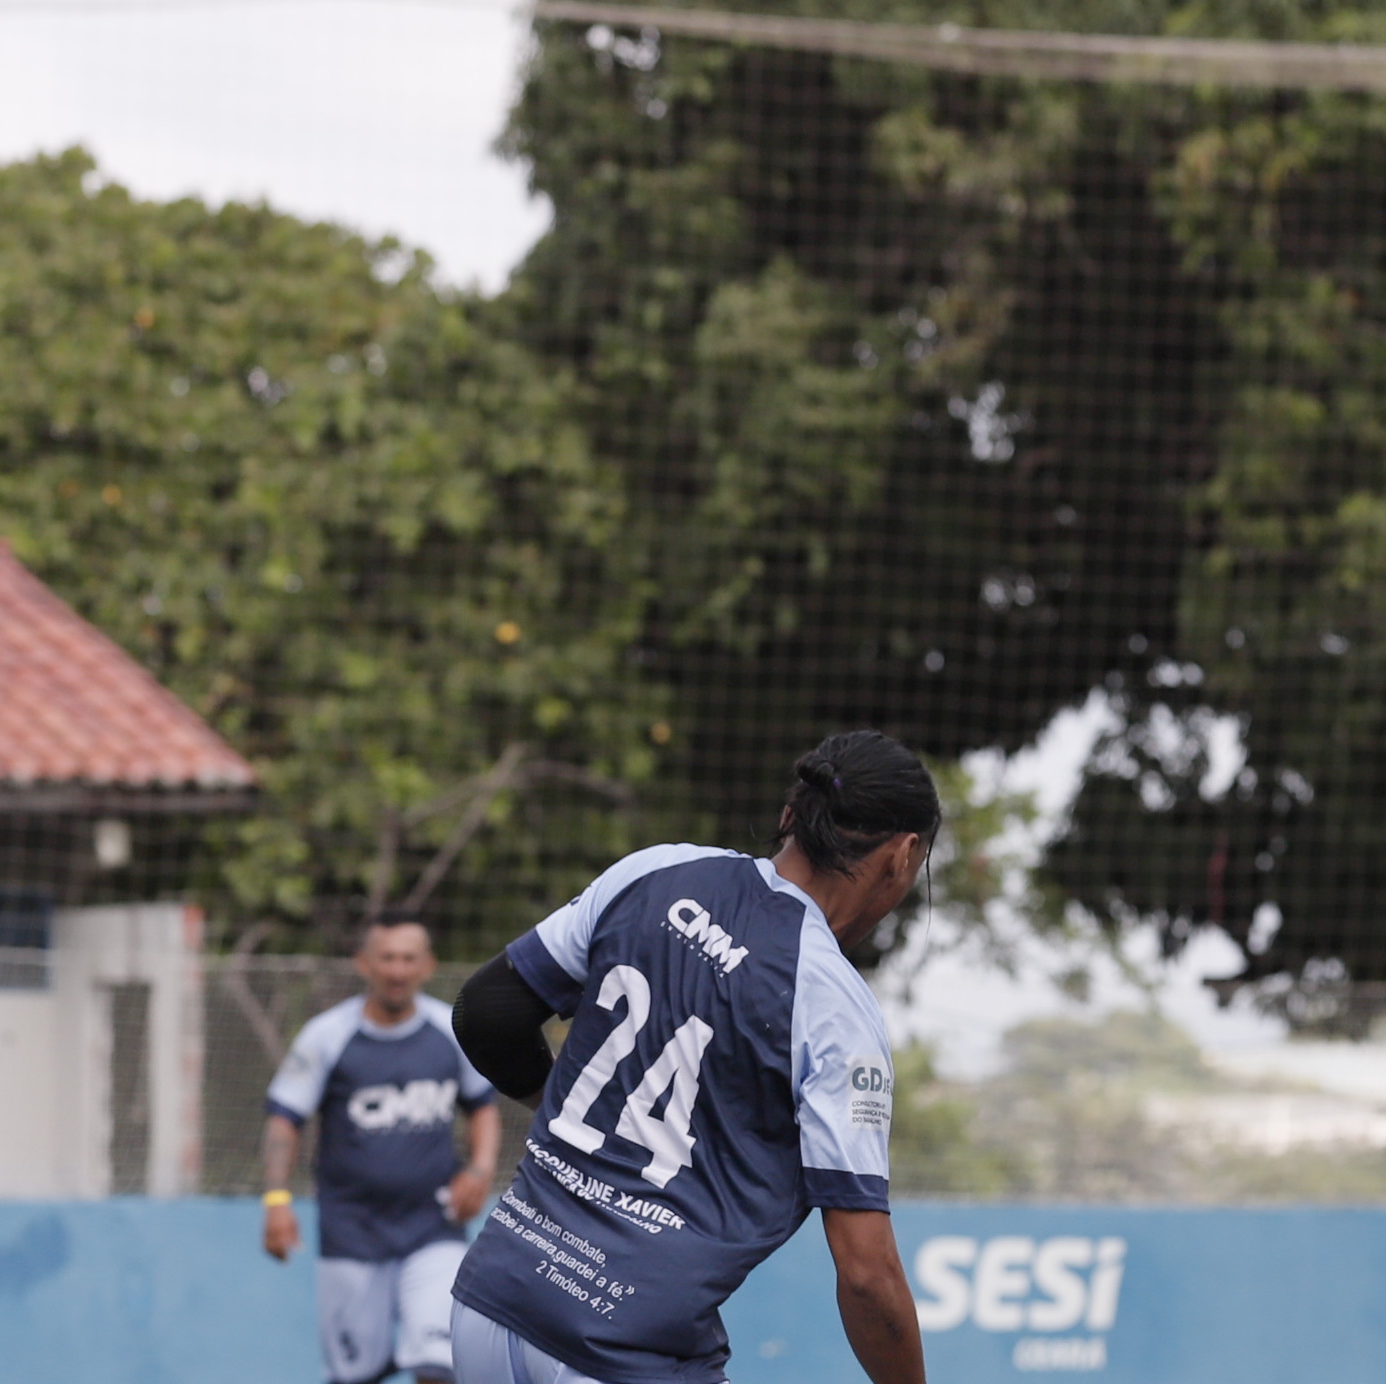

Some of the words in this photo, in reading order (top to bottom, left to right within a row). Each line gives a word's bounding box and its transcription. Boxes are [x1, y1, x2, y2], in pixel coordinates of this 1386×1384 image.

[667, 898, 749, 974] CMM
[548, 964, 714, 1189] 24
[534, 1214, 544, 1225] o
[541, 1215, 562, 1238] bom
[562, 1229, 607, 1268] combate,
[615, 1191, 686, 1231] XAVIER
[514, 1223, 524, 1235] a
[596, 1275, 608, 1289] a
[535, 1260, 547, 1275] 2
[545, 1265, 590, 1302] Timóteo
[589, 1297, 615, 1320] 4:7.
